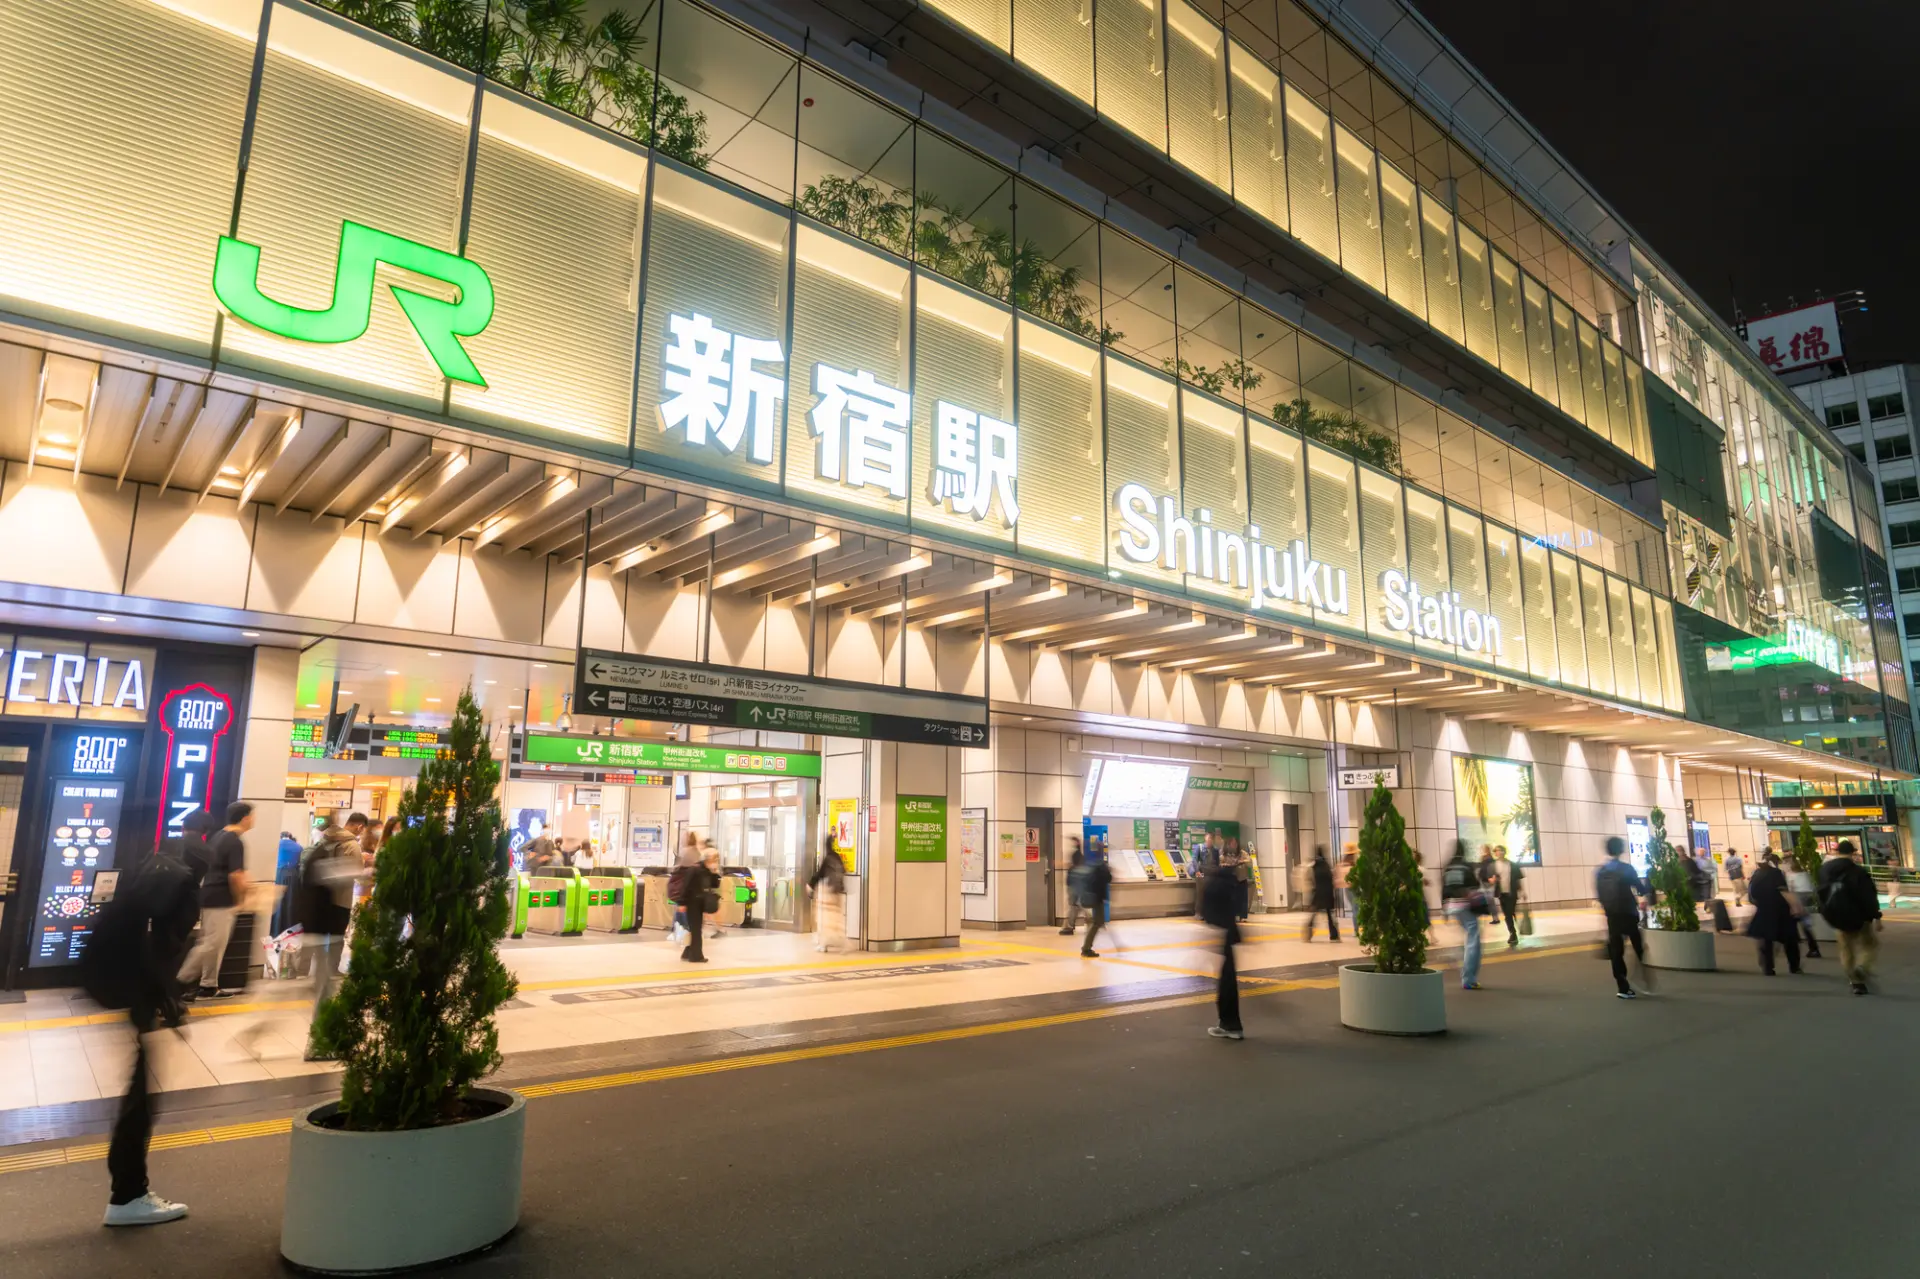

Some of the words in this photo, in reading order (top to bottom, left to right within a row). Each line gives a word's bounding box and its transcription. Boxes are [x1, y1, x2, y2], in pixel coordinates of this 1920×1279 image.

[213, 219, 494, 389] JR
[657, 311, 1020, 528] 新宿駅
[1113, 482, 1349, 615] Shinjuku
[1380, 569, 1502, 656] Station
[0, 648, 145, 710] ERIA
[611, 664, 657, 678] ニュウマン
[660, 669, 688, 681] ルミネ
[689, 672, 706, 684] ゼロ
[723, 677, 807, 694] JR新宿ミライナタワー
[660, 681, 683, 690] LUMINE
[731, 689, 760, 698] SHINJUKU
[784, 694, 804, 702] TOWER
[628, 692, 709, 711] 高速バス・空港バス
[766, 707, 786, 721] JR
[787, 709, 812, 721] 新宿駅
[814, 711, 861, 726] 甲州街道改札
[924, 723, 949, 733] タクシー
[576, 741, 604, 758] JR
[609, 743, 644, 757] 新宿駅
[608, 757, 636, 766] Shinjuku
[636, 758, 658, 766] Station
[905, 801, 917, 810] JR
[900, 821, 943, 833] 甲州街道改札
